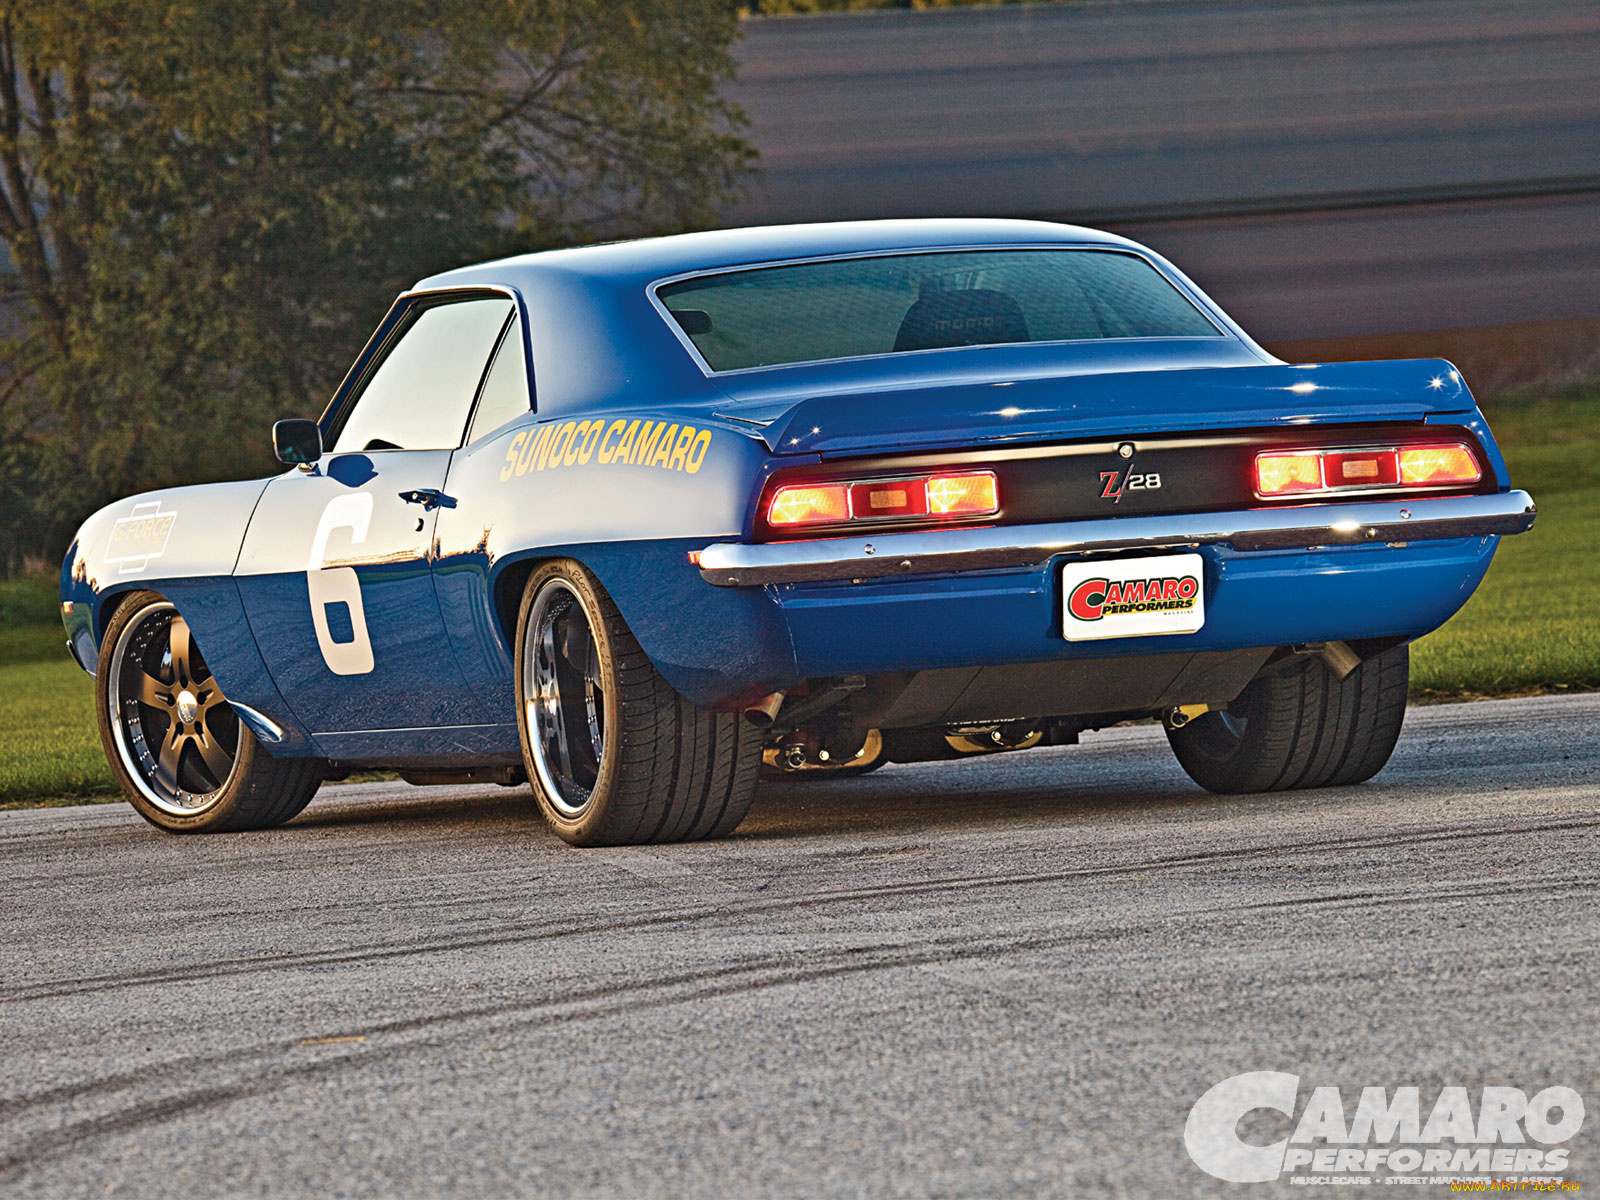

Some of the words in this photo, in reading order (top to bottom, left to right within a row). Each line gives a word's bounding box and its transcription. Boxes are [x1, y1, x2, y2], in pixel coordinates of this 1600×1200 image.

[500, 419, 606, 482] SUNOCO
[598, 419, 712, 475] CAMARO
[1100, 463, 1162, 504] Z/28
[307, 491, 375, 676] 6
[1067, 575, 1199, 621] CAMARO
[1102, 598, 1194, 615] PERFORMERS
